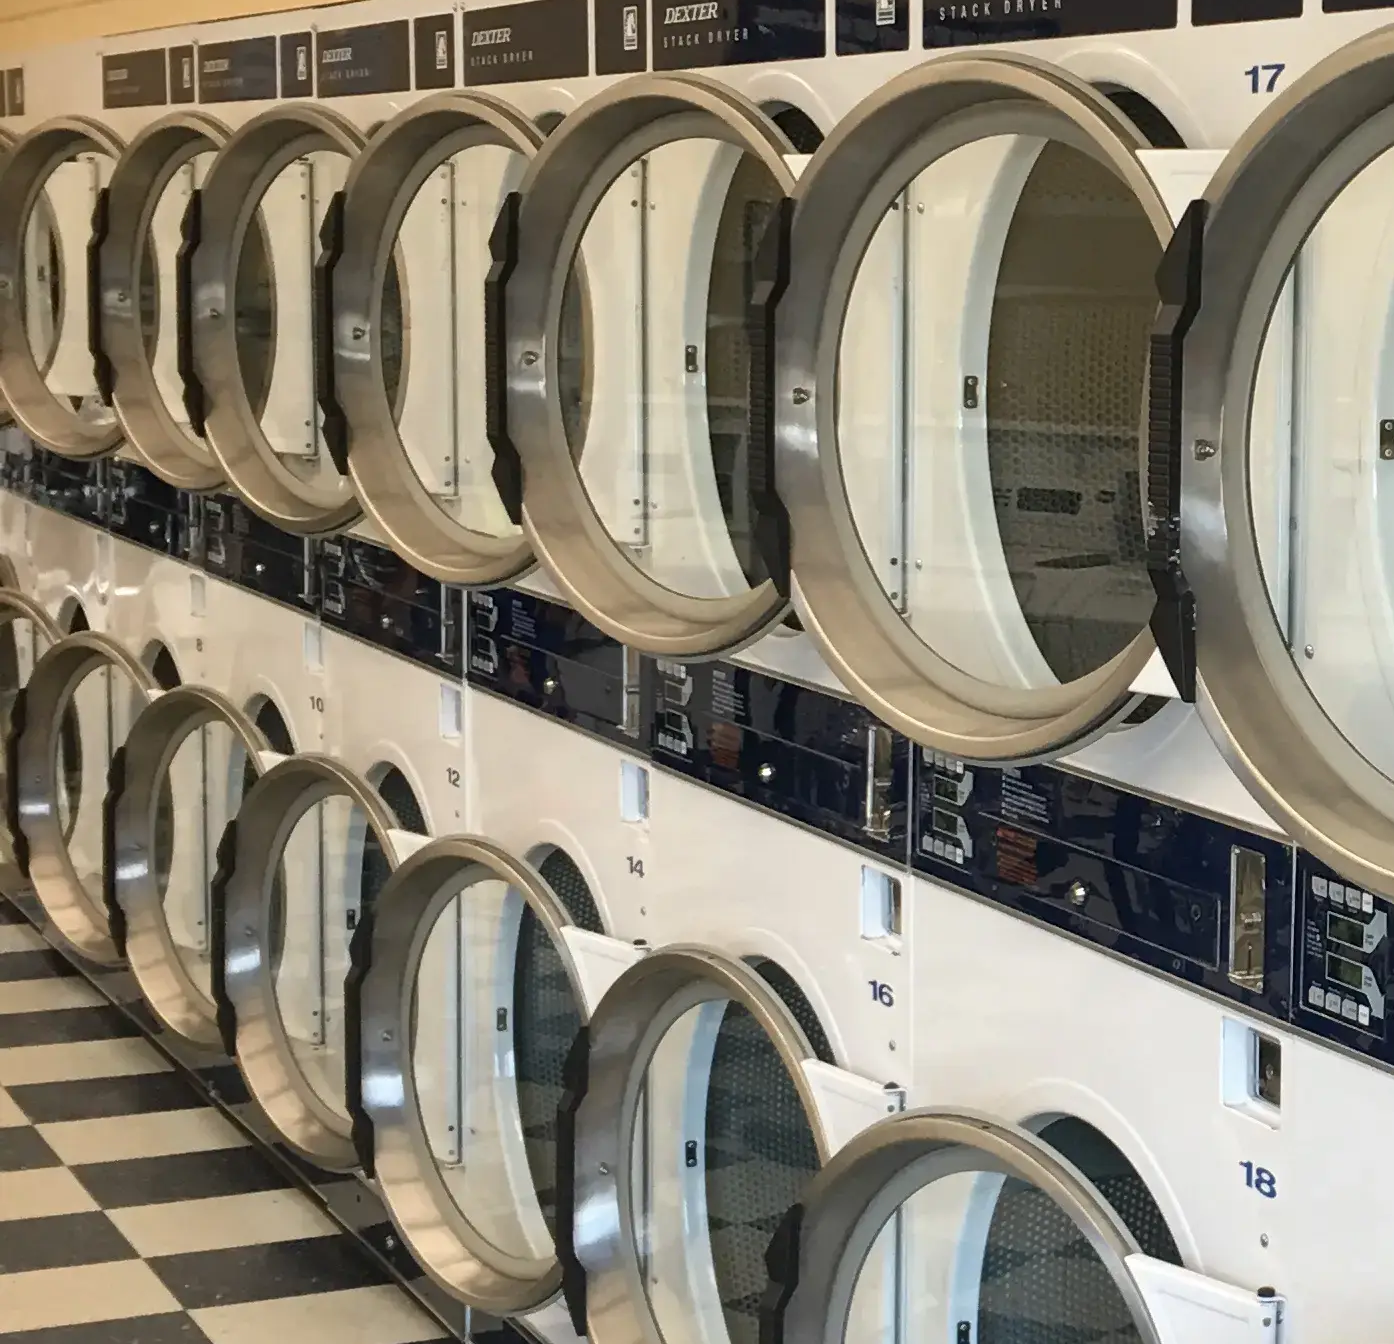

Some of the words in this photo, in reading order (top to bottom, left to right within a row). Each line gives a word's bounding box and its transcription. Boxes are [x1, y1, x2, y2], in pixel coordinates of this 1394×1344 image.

[664, 1, 719, 25] DEXTER
[939, 2, 991, 21] STACK
[471, 27, 511, 47] DEXTER
[1245, 64, 1285, 94] 17
[309, 695, 323, 713] 10
[446, 767, 460, 787] 12
[626, 856, 645, 878] 14
[867, 979, 894, 1008] 16
[1239, 1160, 1277, 1198] 18
